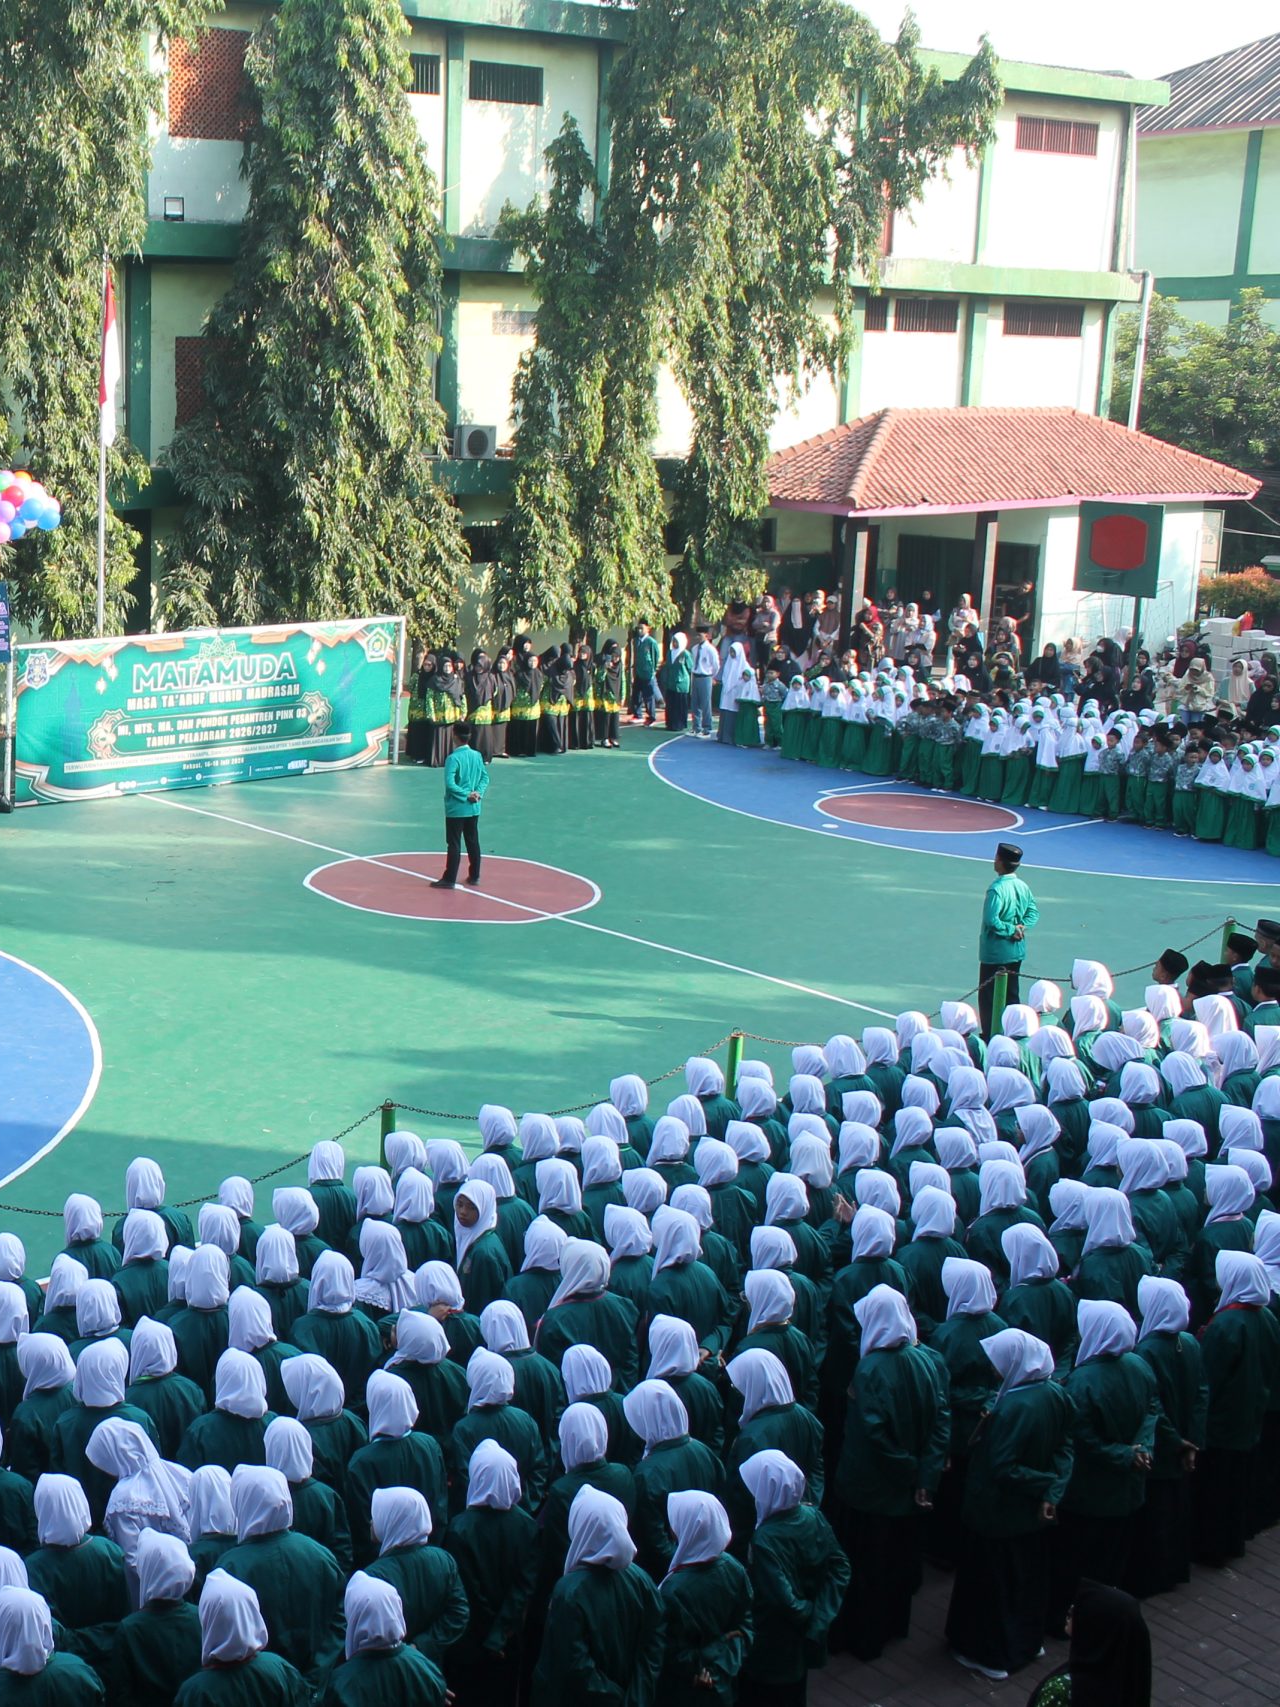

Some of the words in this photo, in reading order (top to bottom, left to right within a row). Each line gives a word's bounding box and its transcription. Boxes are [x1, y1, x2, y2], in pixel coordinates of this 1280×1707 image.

[133, 652, 297, 693] MATAMUDA
[127, 697, 157, 711] MASA
[162, 692, 205, 708] TA'ARUF
[209, 689, 243, 703] MURID
[245, 684, 300, 700] MADRASAH
[176, 719, 193, 731] DAN
[195, 716, 228, 729] PONDOK
[230, 712, 274, 726] PESANTREN
[275, 710, 294, 721] PINK
[146, 735, 176, 748] TAHUN
[179, 729, 226, 744] PELAJARAN
[229, 723, 277, 738] 2026/2027
